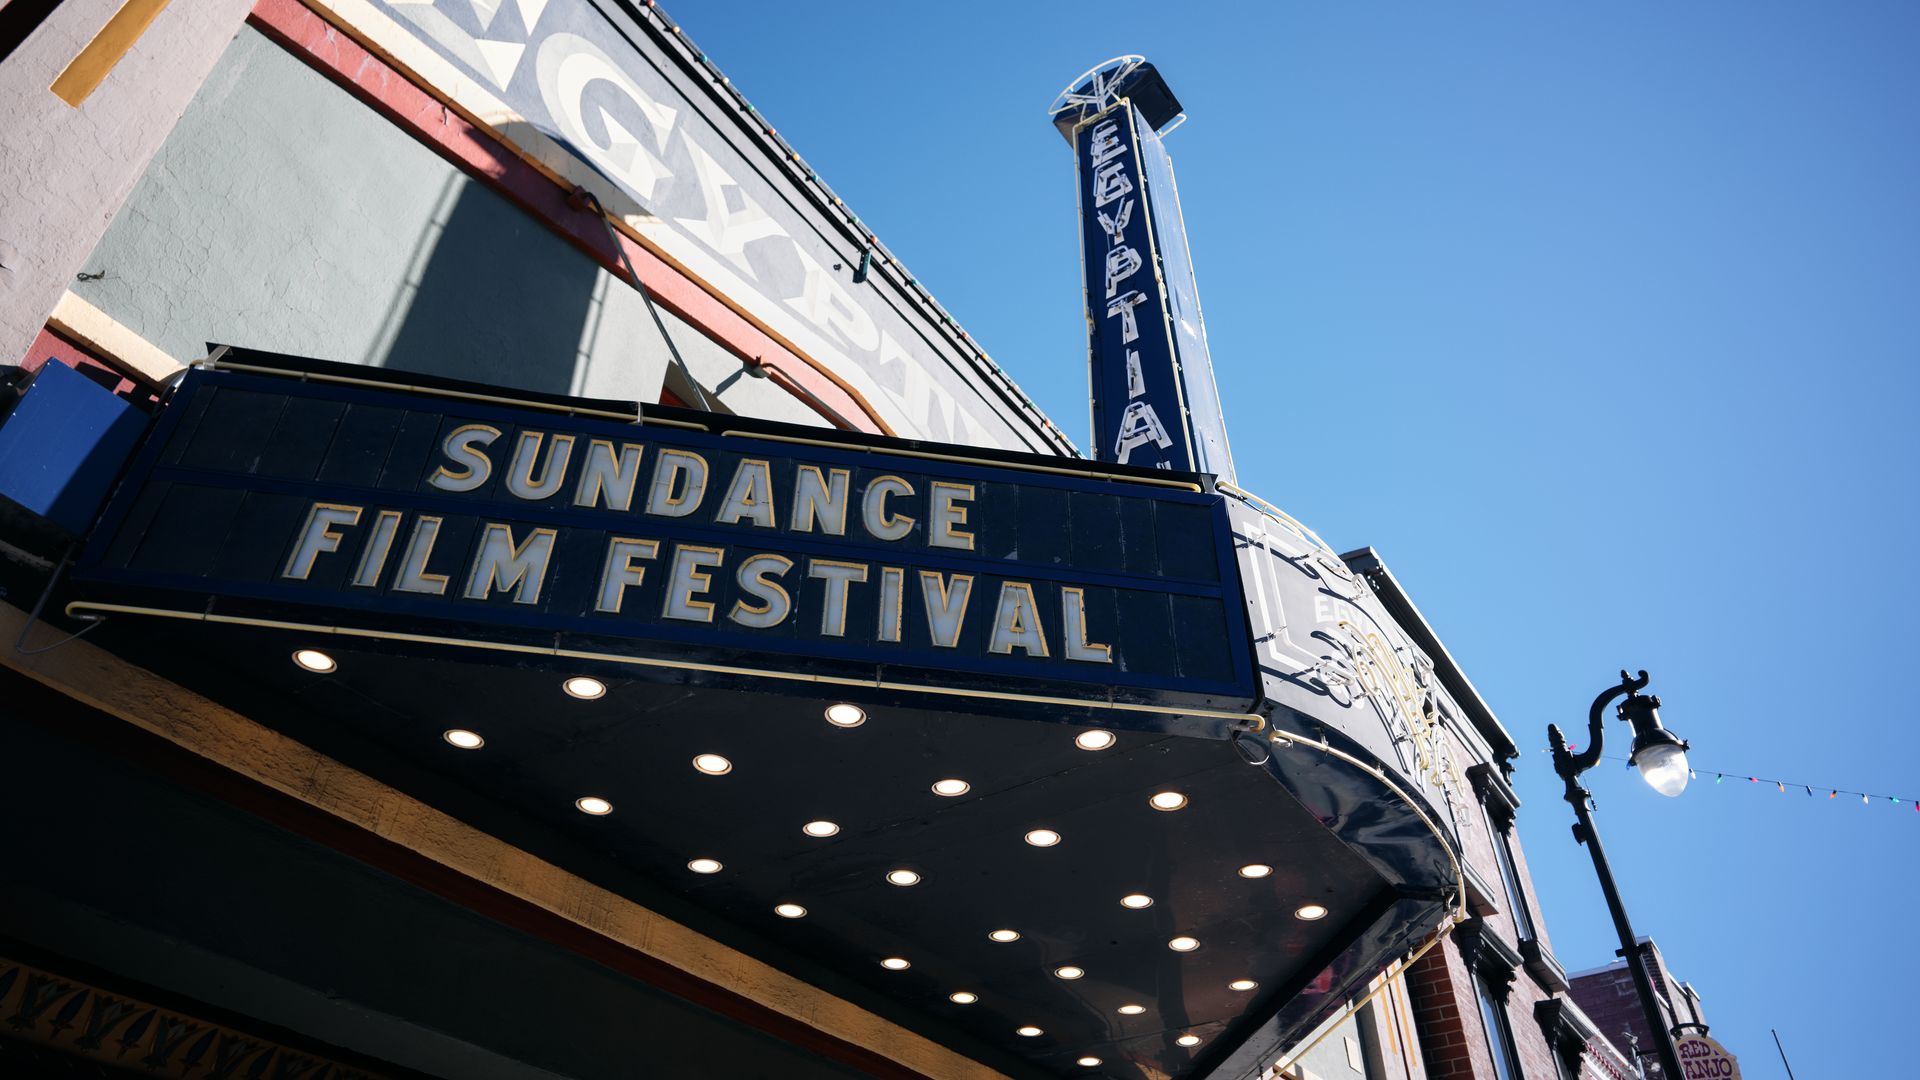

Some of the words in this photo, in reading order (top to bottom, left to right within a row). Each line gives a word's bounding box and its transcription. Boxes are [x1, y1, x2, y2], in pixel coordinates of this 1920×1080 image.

[1092, 118, 1173, 470] EGYPTIA
[427, 424, 976, 551] SUNDANCE
[281, 502, 558, 605] FILM
[595, 536, 1113, 664] FESTIVAL
[1679, 1040, 1711, 1058] RED
[1683, 1057, 1733, 1079] ANJO
